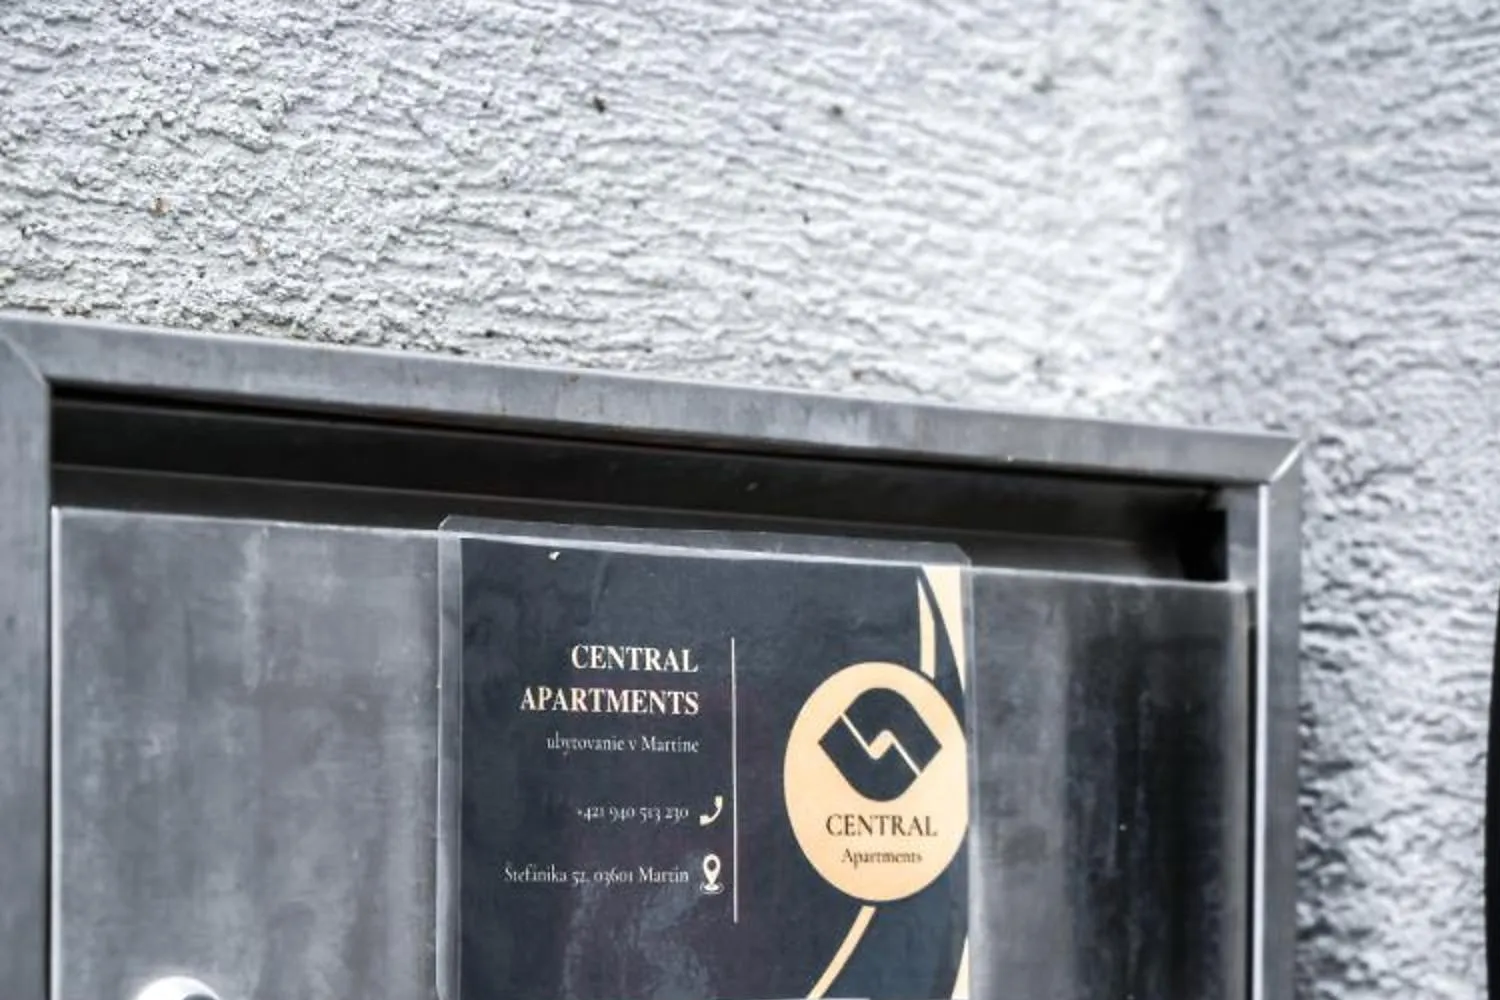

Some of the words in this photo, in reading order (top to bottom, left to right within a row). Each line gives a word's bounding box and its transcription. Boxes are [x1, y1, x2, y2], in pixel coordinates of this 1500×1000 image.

[571, 644, 699, 673] CENTRAL
[520, 686, 699, 715] APARTMENTS
[629, 741, 638, 751] v
[641, 736, 699, 753] Martine
[609, 806, 635, 823] 940
[639, 806, 661, 824] 513
[665, 807, 689, 823] 230
[826, 813, 938, 837] CENTRAL
[841, 848, 923, 869] Apartments
[593, 868, 634, 887] 03601
[639, 866, 689, 882] Martin
